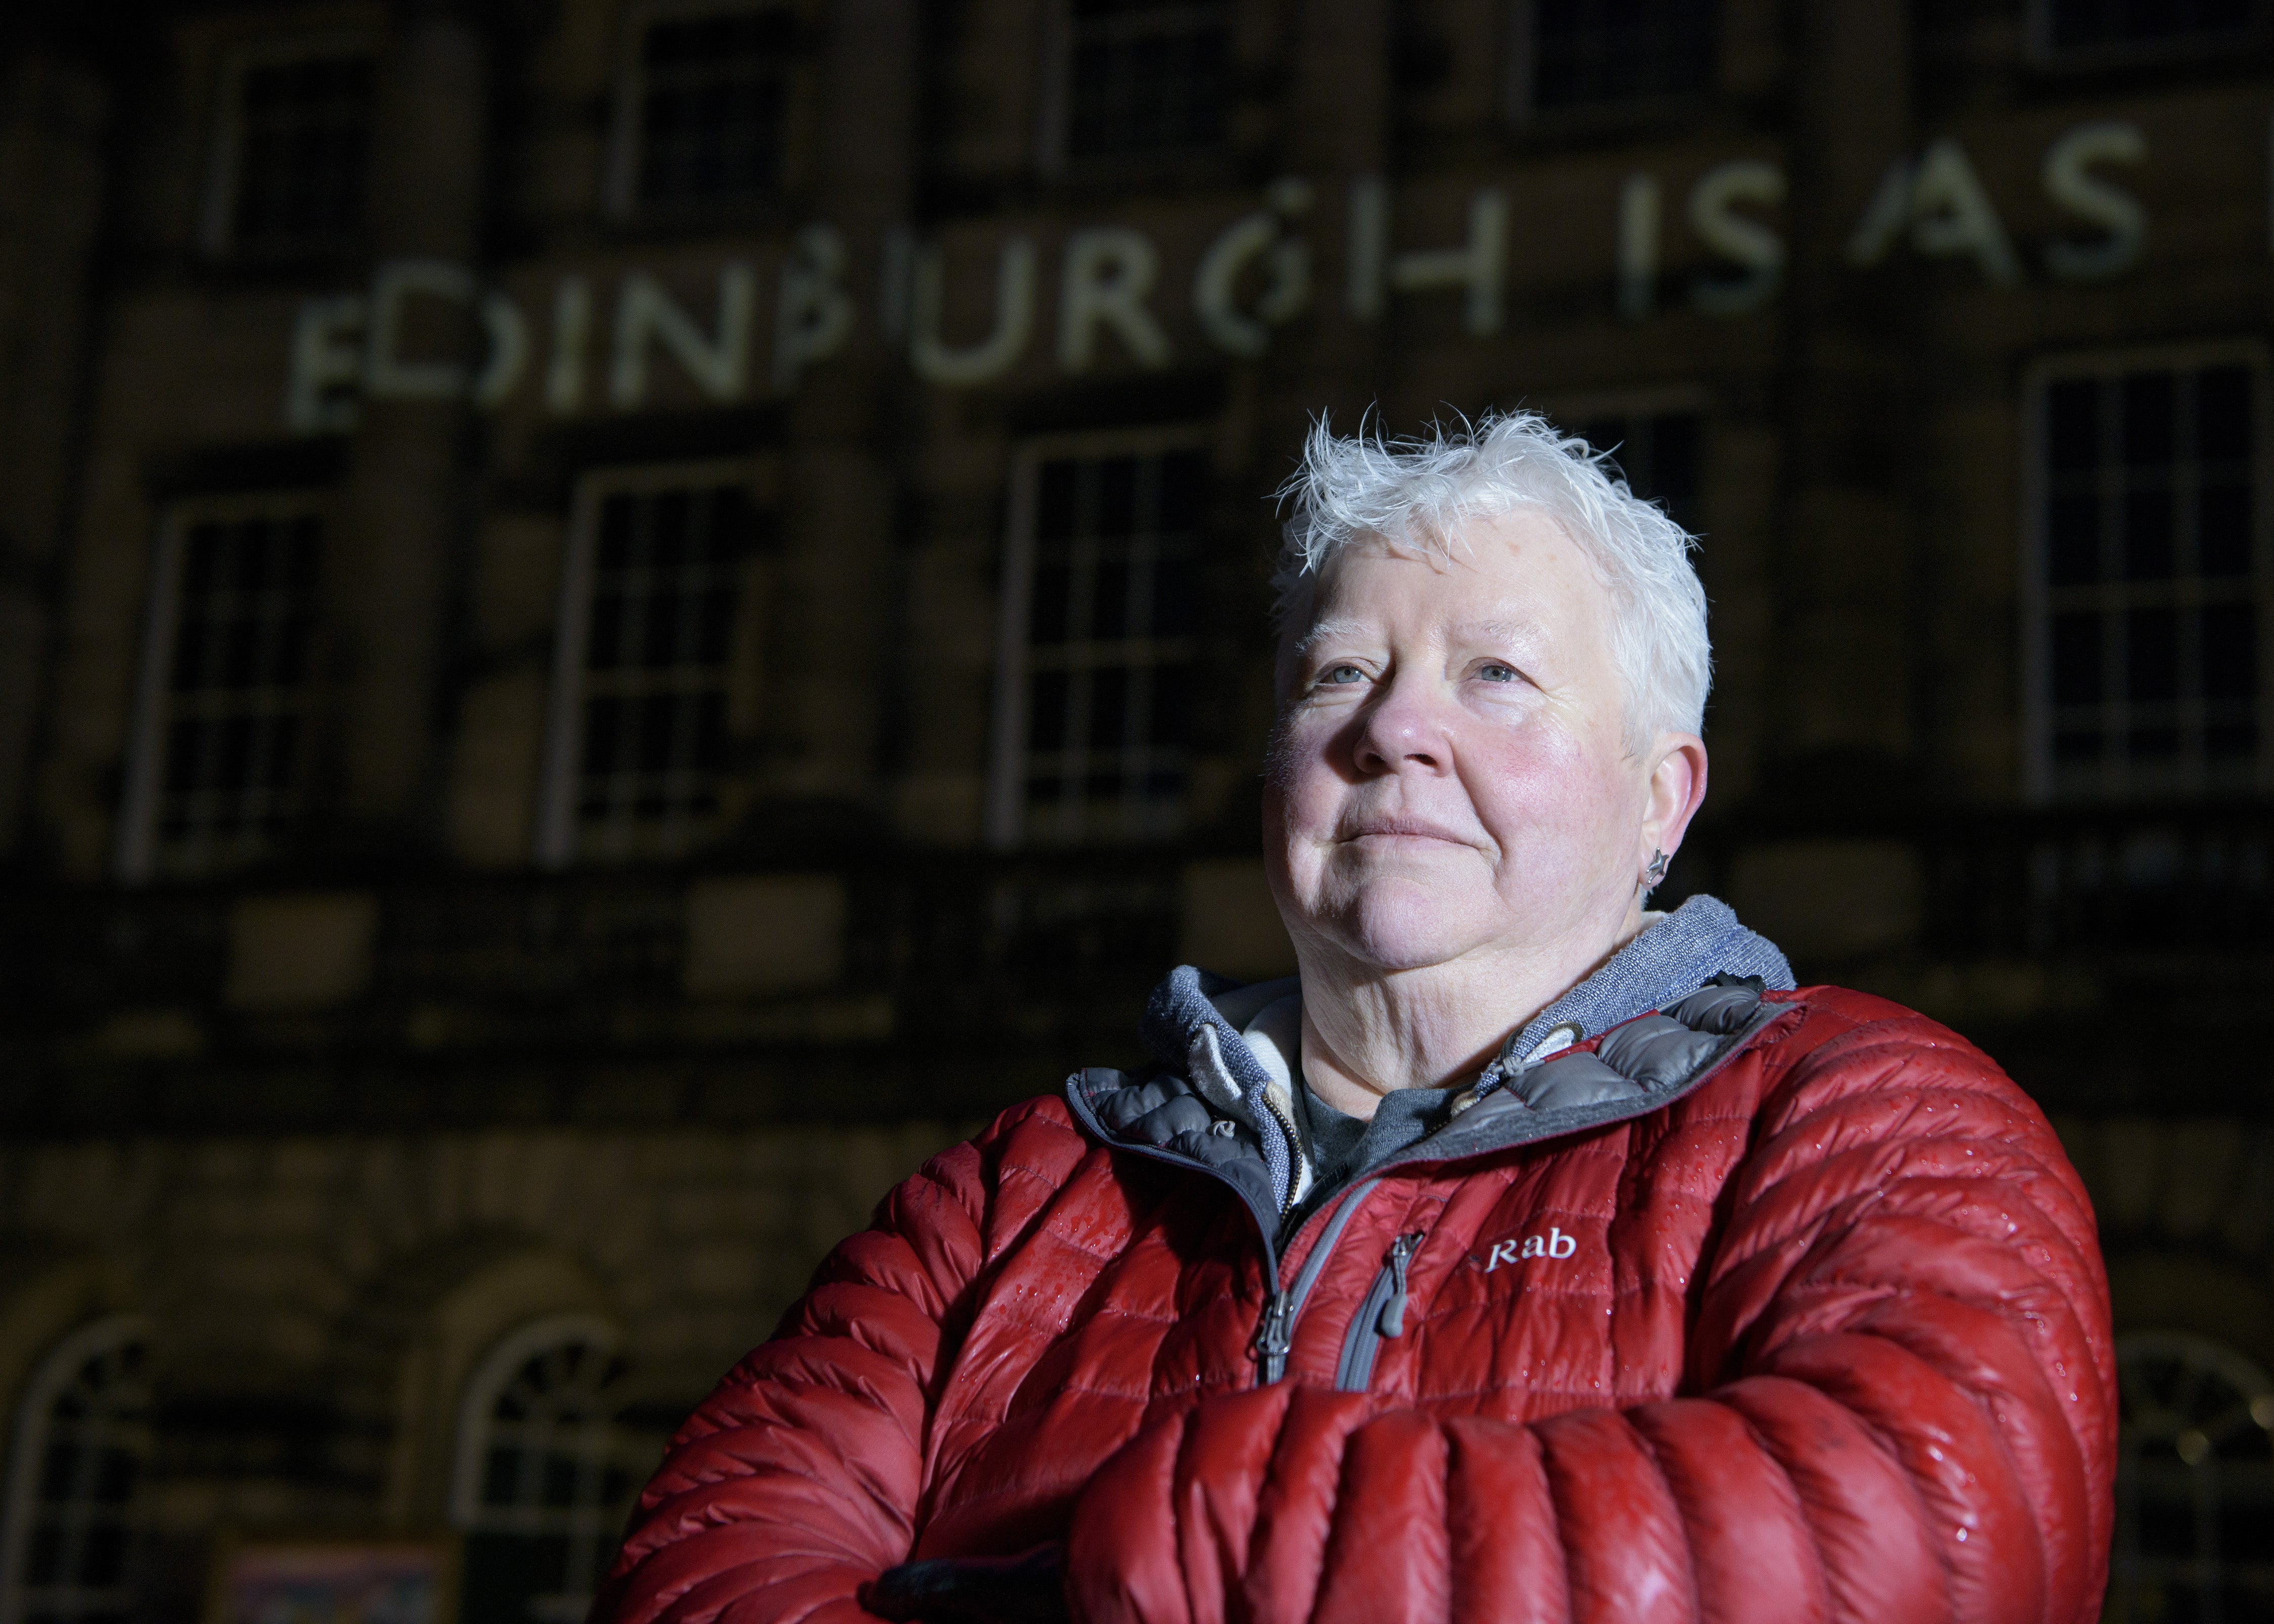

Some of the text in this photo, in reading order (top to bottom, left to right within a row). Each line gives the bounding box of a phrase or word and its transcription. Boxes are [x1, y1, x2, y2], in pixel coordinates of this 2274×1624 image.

[285, 171, 1510, 437] EDINBURGH
[1614, 156, 1790, 323] IS
[1842, 117, 2152, 291] AS
[1485, 1227, 1577, 1273] Rab
